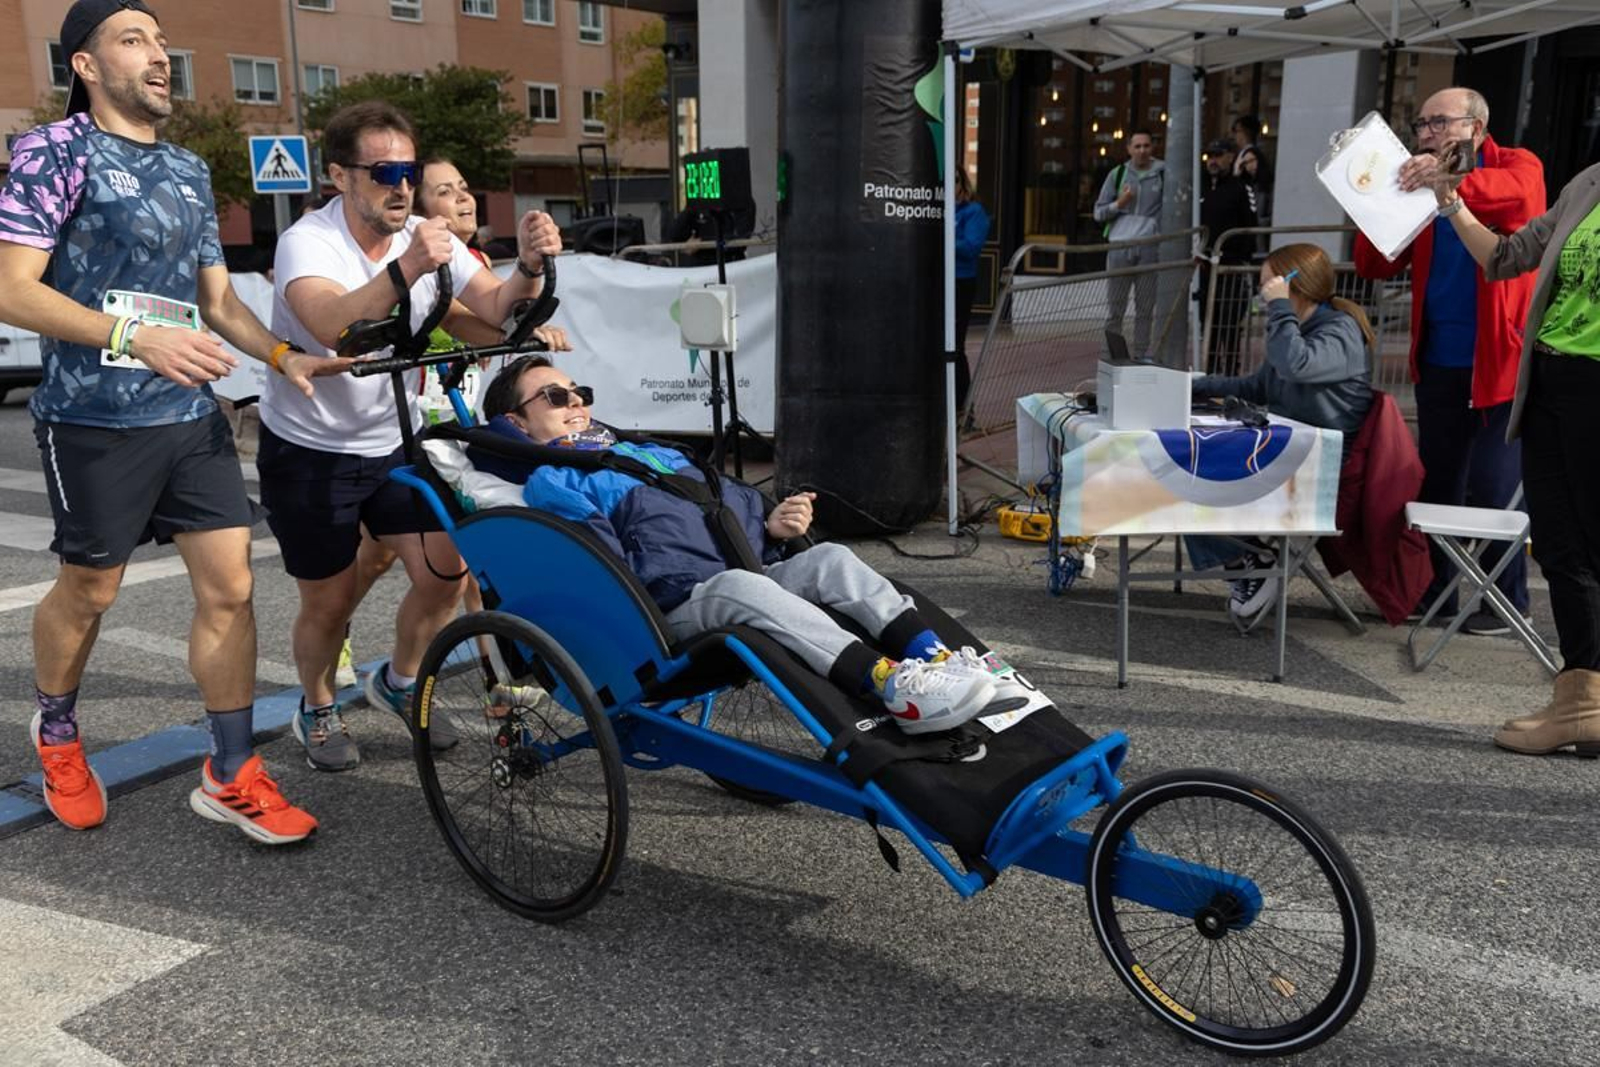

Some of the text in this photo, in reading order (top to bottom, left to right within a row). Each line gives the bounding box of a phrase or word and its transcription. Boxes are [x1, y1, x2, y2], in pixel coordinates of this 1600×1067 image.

[864, 182, 933, 201] Patronato
[884, 201, 942, 221] Deportes
[640, 378, 686, 390] Patronato
[738, 376, 750, 388] de
[652, 391, 698, 404] Deportes
